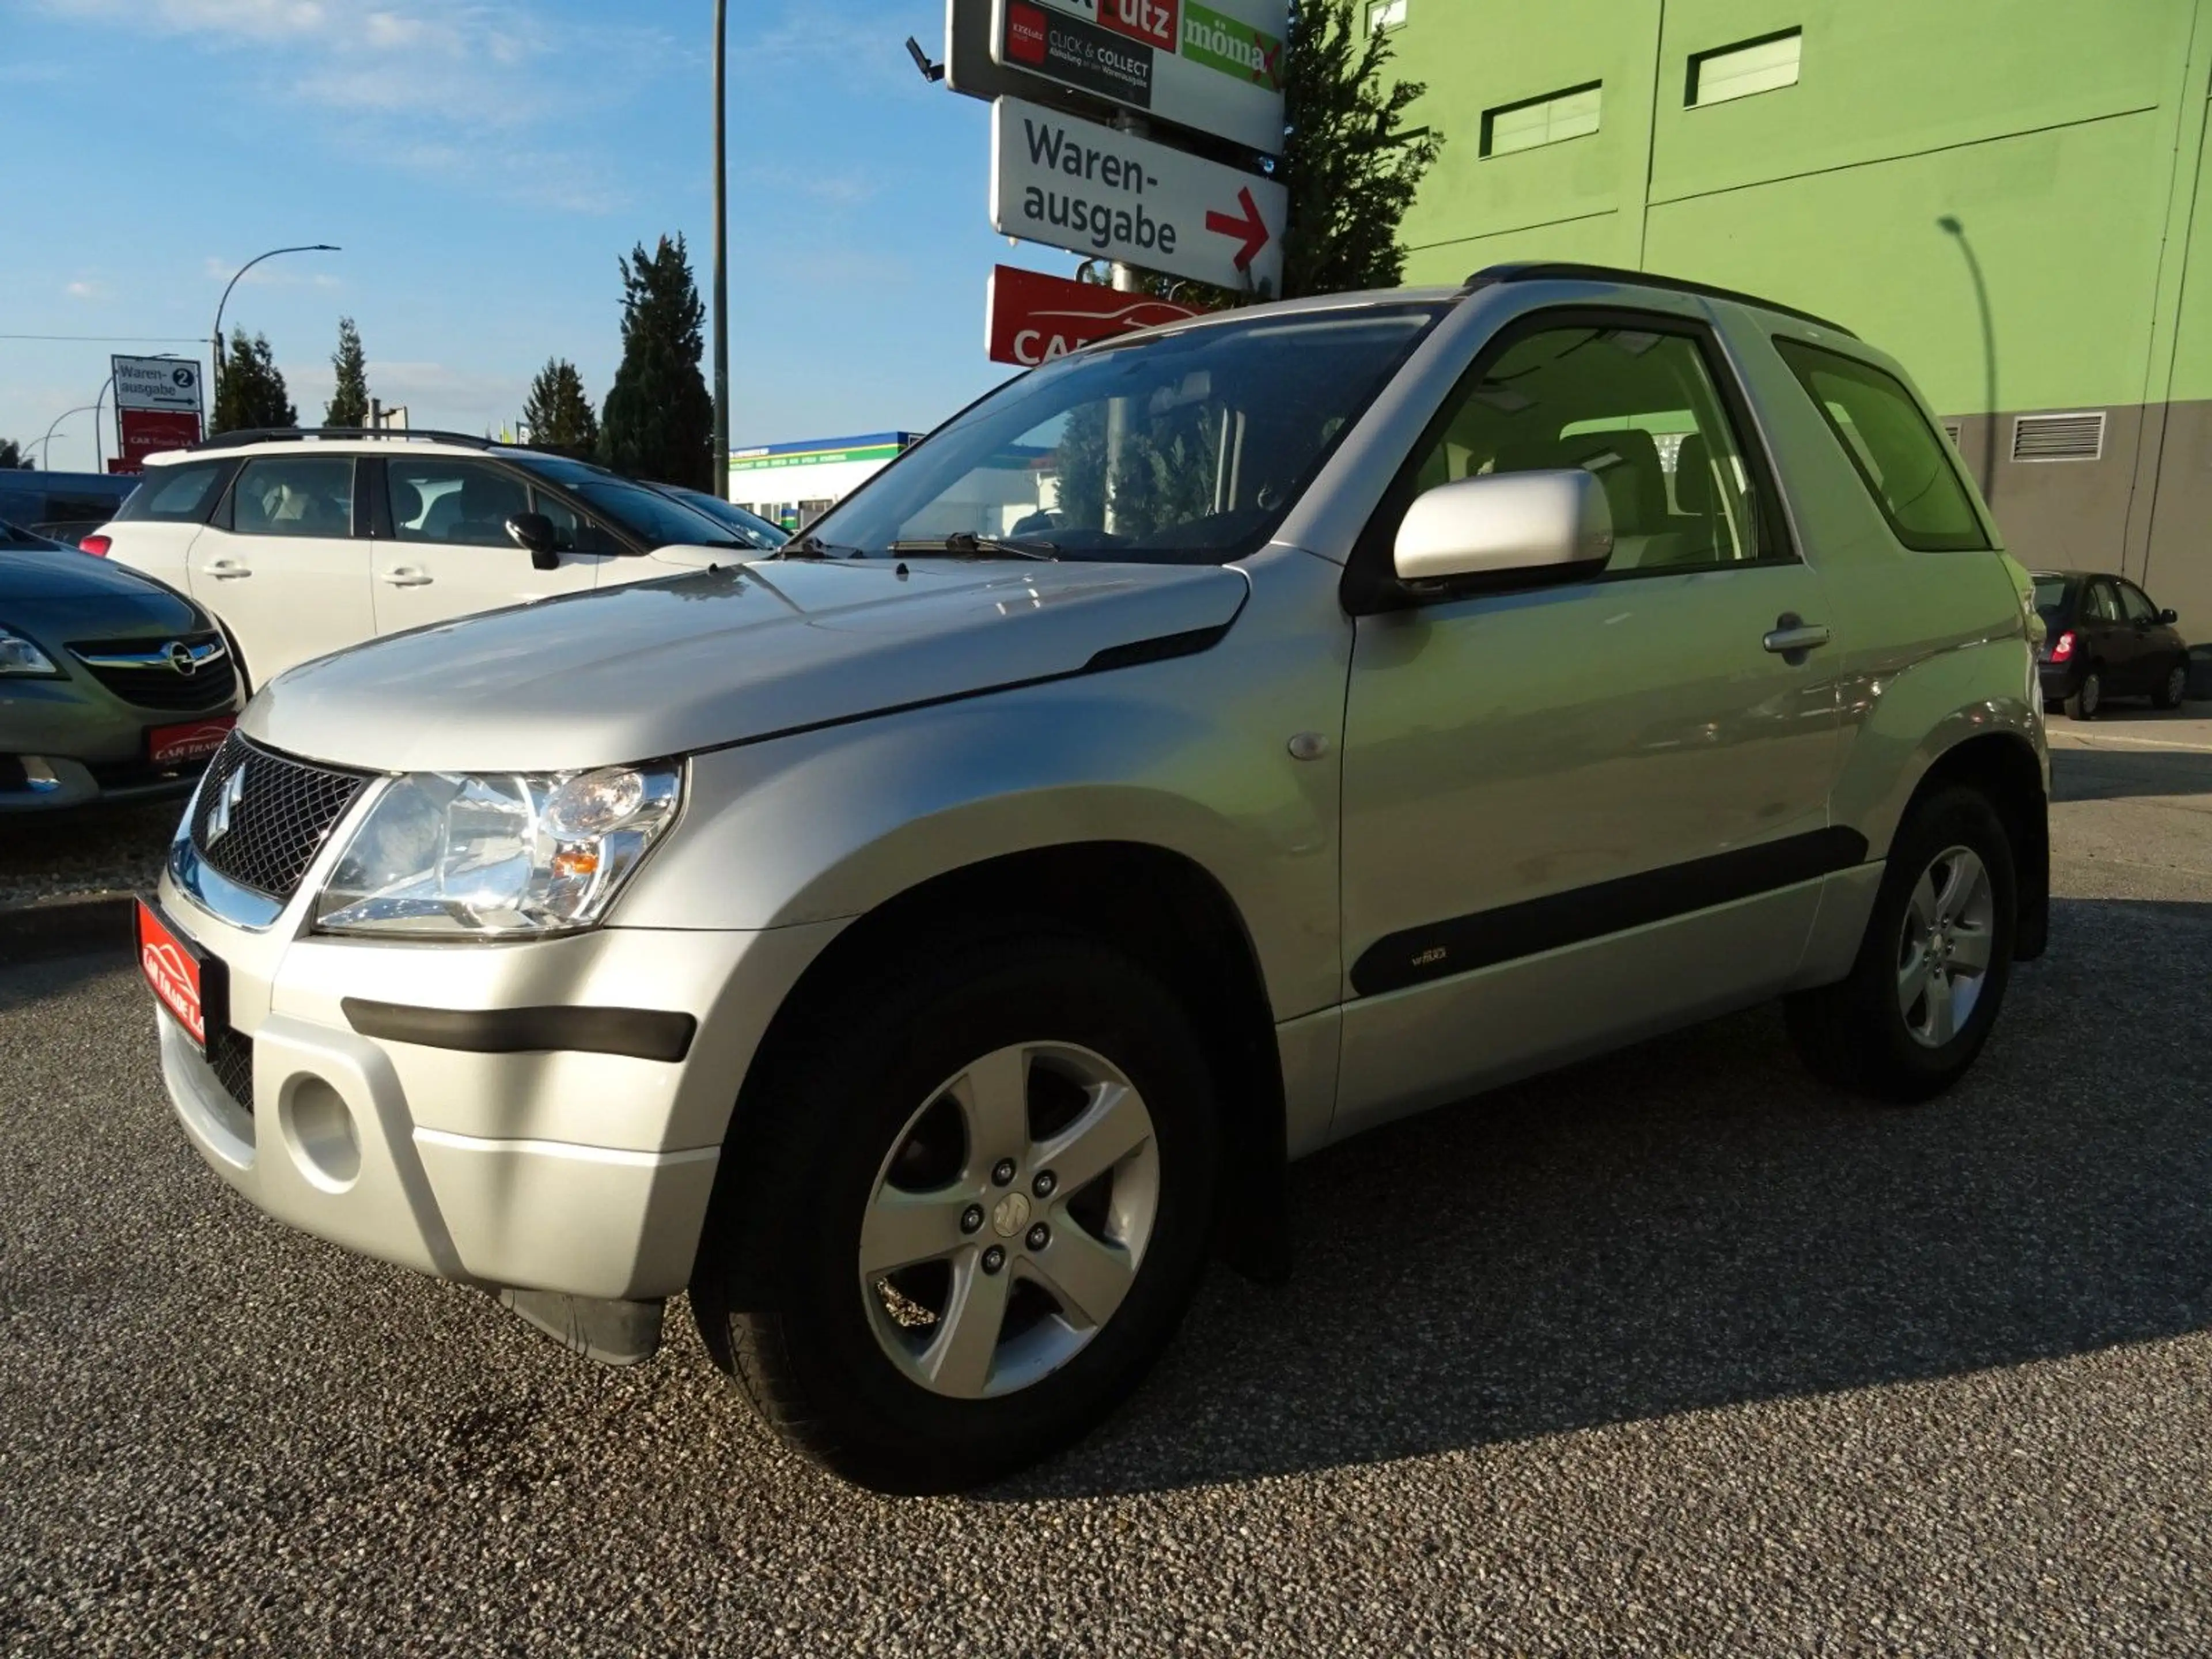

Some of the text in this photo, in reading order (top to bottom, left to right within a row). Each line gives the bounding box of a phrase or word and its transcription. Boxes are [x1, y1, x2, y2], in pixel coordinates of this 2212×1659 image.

[1048, 30, 1084, 54] CLICK
[1085, 41, 1094, 58] &
[1097, 48, 1149, 78] COLLECT
[1024, 118, 1158, 195] Waren-
[1024, 186, 1176, 254] ausgabe
[1013, 329, 1089, 365] CA
[120, 365, 188, 385] Waren- 2
[121, 382, 177, 397] ausgabe
[189, 1003, 204, 1032] LA
